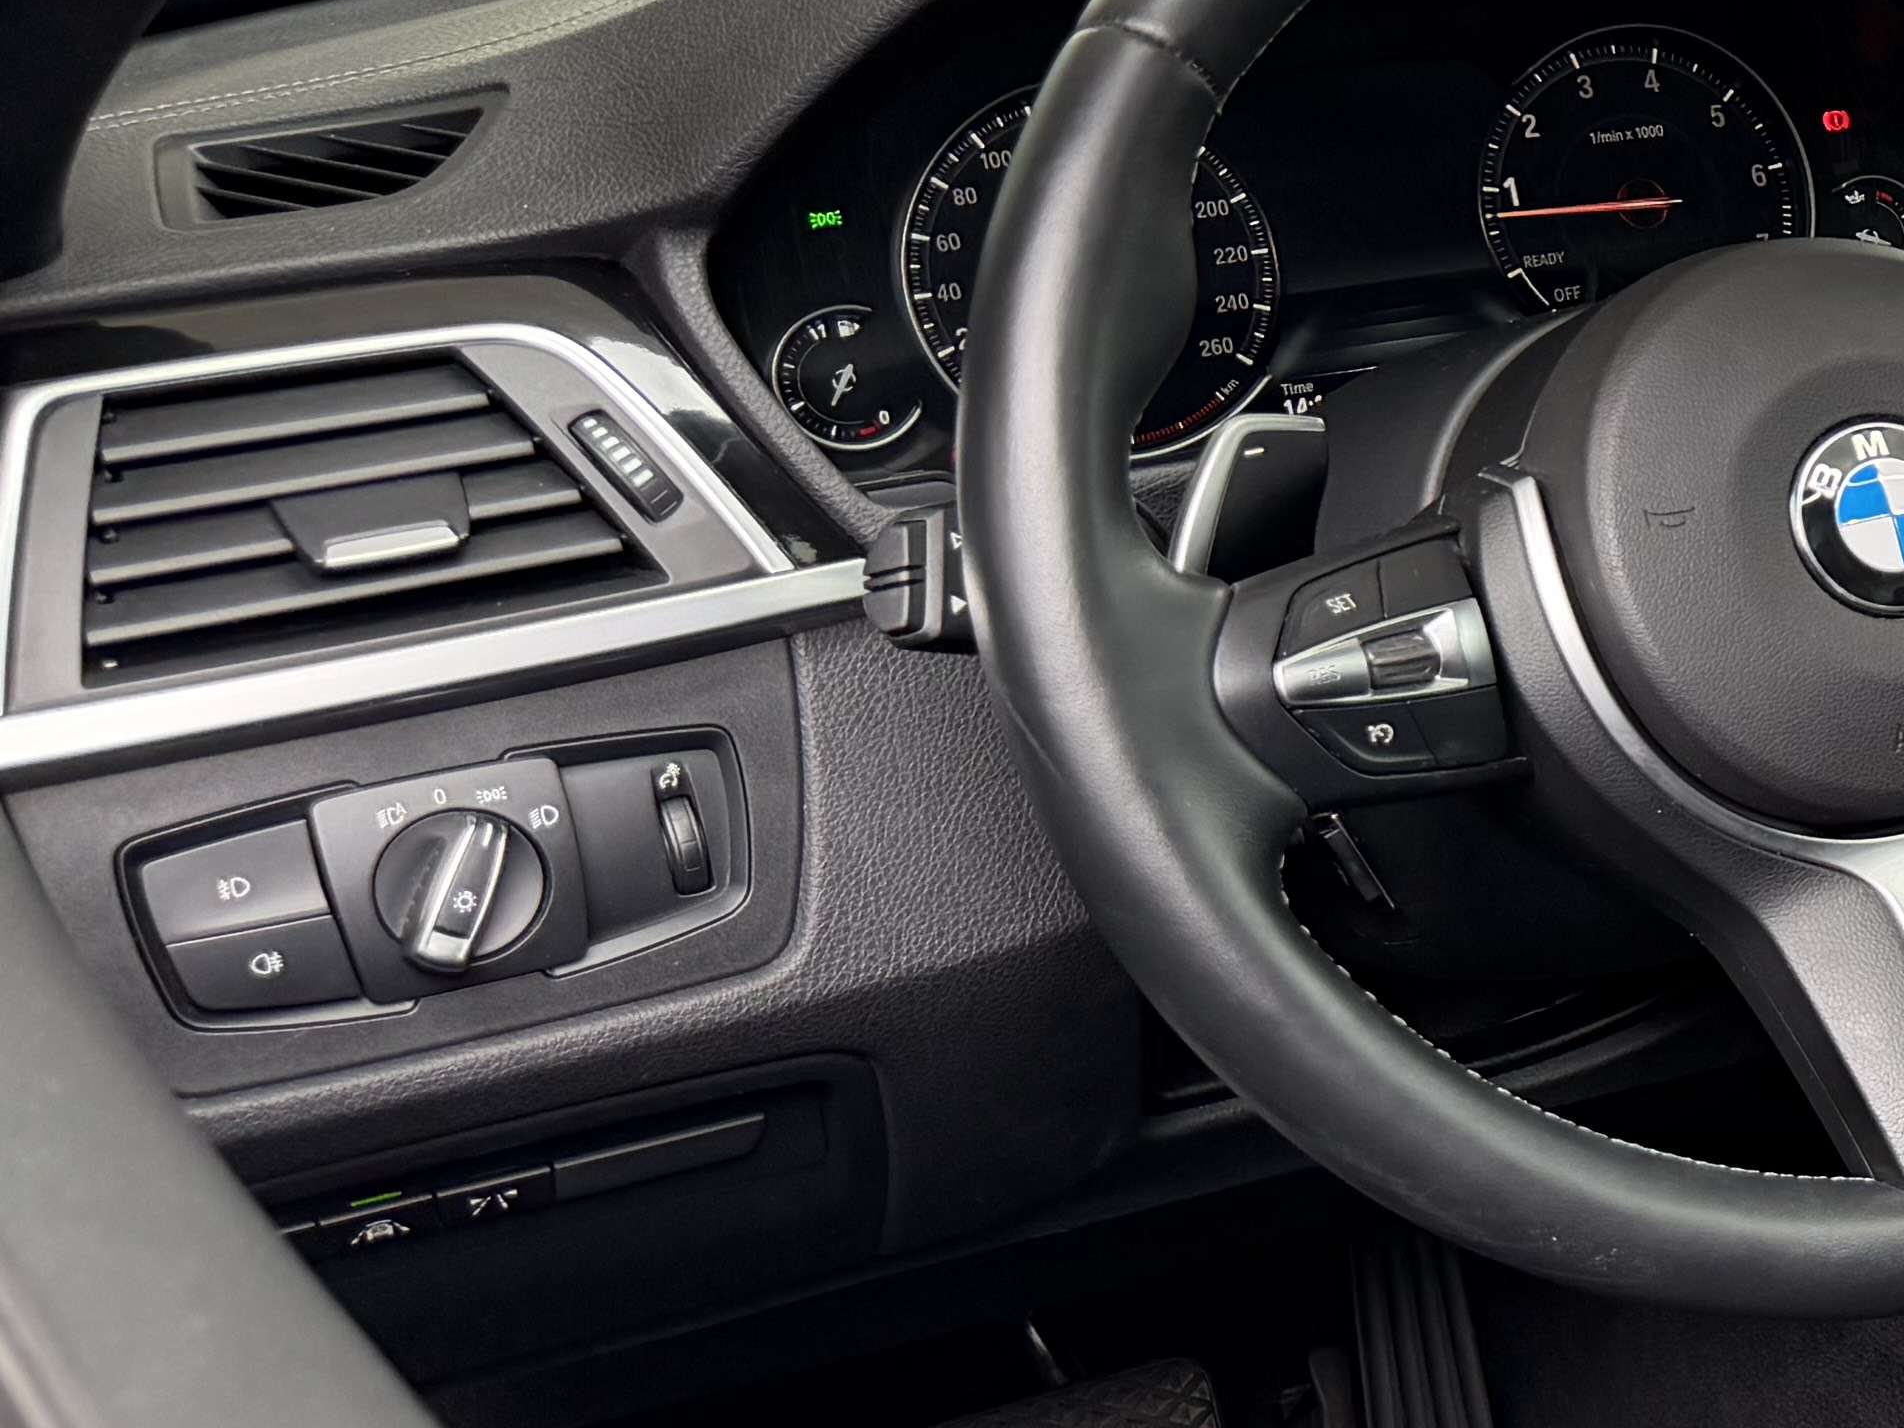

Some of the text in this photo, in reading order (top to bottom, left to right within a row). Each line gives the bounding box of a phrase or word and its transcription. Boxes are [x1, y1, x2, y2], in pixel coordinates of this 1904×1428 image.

[1576, 74, 1594, 99] 3
[1644, 69, 1660, 92] 4
[1521, 113, 1541, 139] 2
[1710, 104, 1726, 128] 5
[1589, 129, 1624, 145] 1/min
[1635, 123, 1664, 140] 1000
[979, 149, 1012, 170] 100
[1751, 164, 1767, 187] 6
[953, 186, 978, 206] 80
[1502, 176, 1520, 206] 1
[1195, 199, 1229, 219] 200
[936, 232, 961, 252] 60
[1213, 244, 1248, 265] 220
[1523, 251, 1565, 269] READY
[937, 282, 962, 303] 40
[1215, 293, 1249, 313] 240
[1553, 285, 1582, 302] OFF
[1199, 336, 1234, 357] 260
[1280, 381, 1315, 396] Time
[878, 410, 890, 425] 0
[1325, 592, 1357, 614] SET
[1307, 664, 1342, 686] RES
[433, 788, 447, 805] 0
